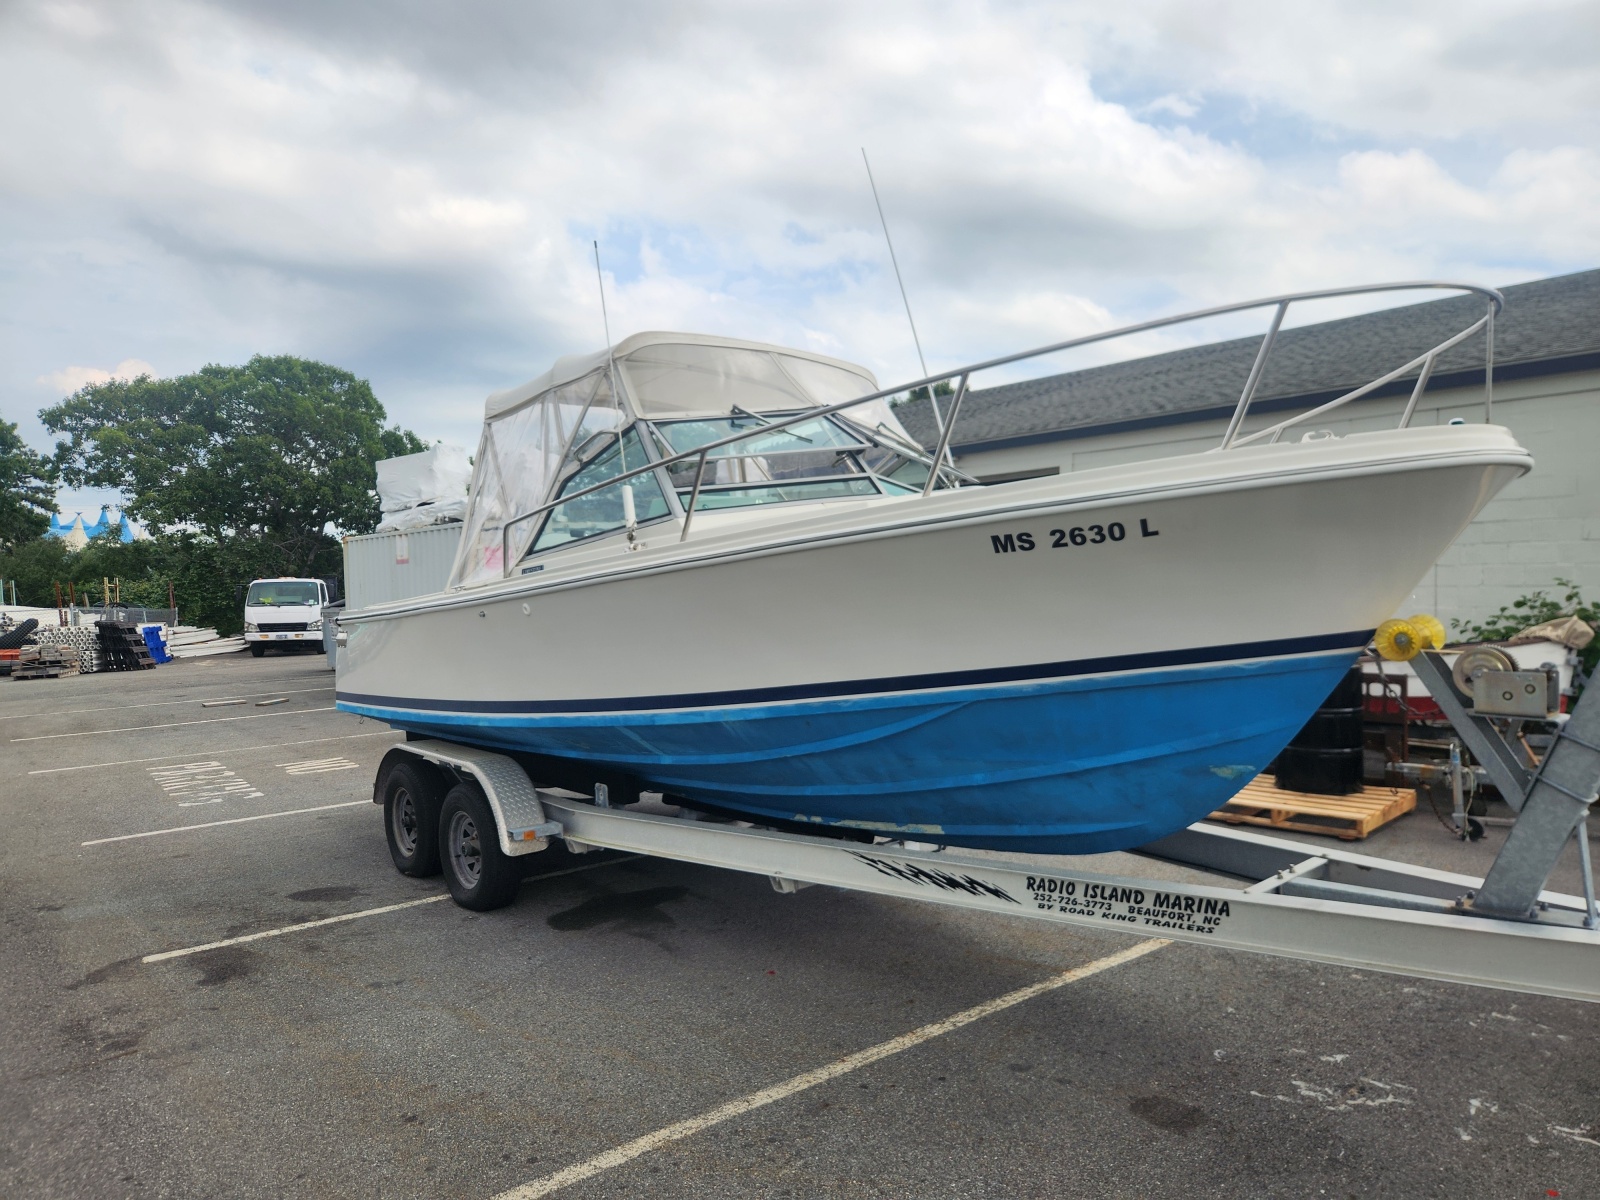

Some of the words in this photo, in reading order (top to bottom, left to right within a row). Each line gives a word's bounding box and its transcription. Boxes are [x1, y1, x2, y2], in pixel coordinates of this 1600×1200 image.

[990, 532, 1036, 553] MS
[1049, 522, 1126, 548] 2630
[1139, 518, 1159, 538] L
[1026, 876, 1076, 896] RADIO
[1083, 883, 1145, 905] ISLAND
[1153, 892, 1230, 917] MARINA
[1033, 892, 1112, 911] 252-726-3773
[1128, 905, 1196, 925] BEAUFORT,
[1202, 916, 1221, 926] NC
[1037, 902, 1054, 910] BY
[1059, 906, 1095, 916] ROAD
[1101, 912, 1137, 923] KING
[1143, 917, 1215, 934] TRAILERS
